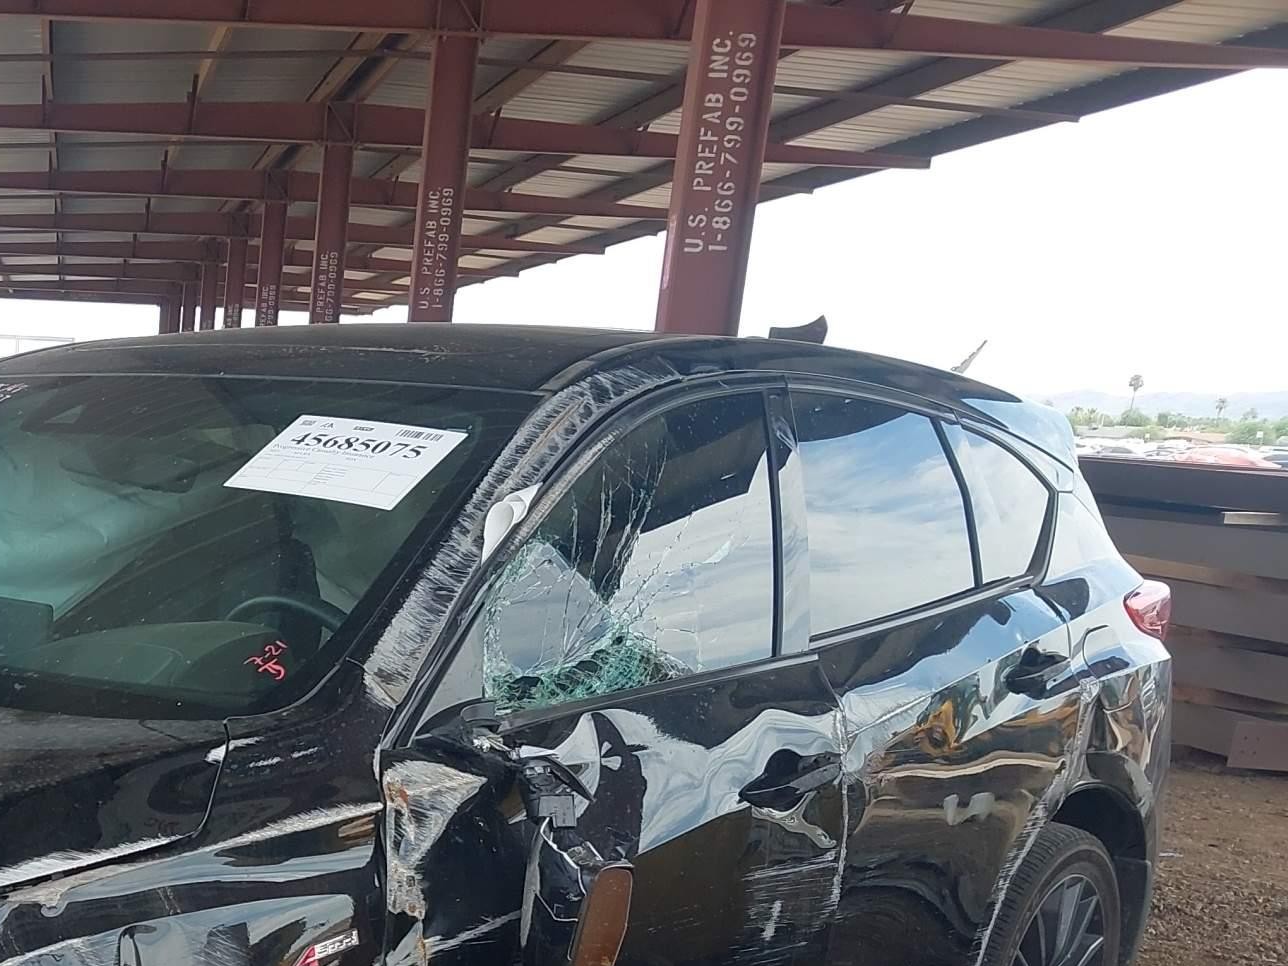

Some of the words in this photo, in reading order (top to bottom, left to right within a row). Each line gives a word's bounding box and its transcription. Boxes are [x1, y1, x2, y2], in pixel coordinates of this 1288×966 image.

[708, 31, 735, 79] INC.
[693, 93, 724, 191] PREFAB
[708, 32, 757, 252] 1-866-799-0969
[427, 186, 442, 213] INC.
[422, 220, 438, 276] PREFAB
[683, 207, 710, 253] U.S.
[315, 274, 328, 313] PREFAB
[290, 431, 429, 459] 45685075
